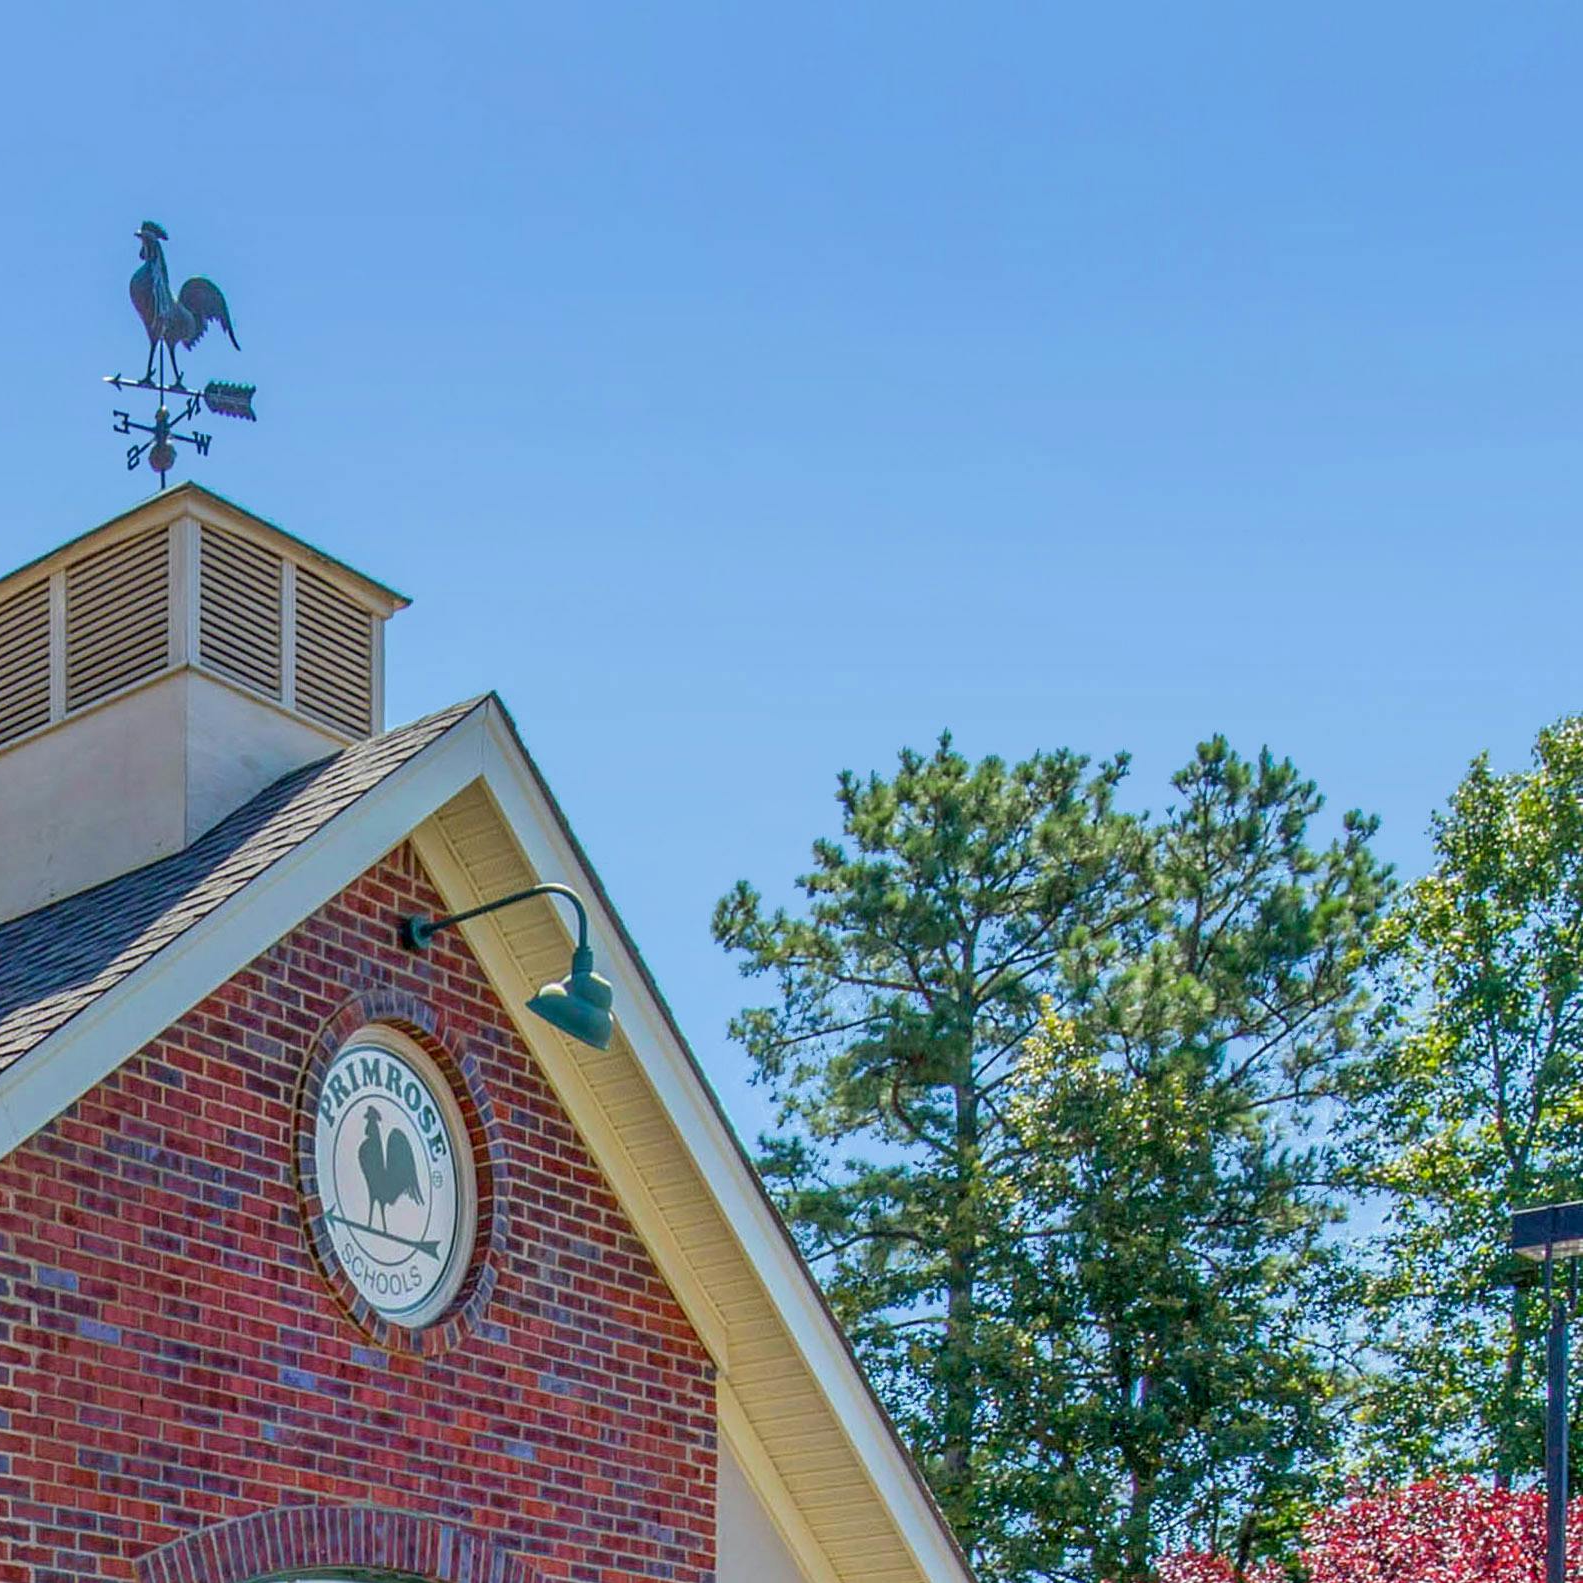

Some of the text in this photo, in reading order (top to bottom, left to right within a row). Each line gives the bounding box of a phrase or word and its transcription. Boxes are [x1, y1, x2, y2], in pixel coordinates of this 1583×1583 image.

[193, 431, 213, 456] W
[319, 1057, 447, 1163] PRIMROSE
[340, 1241, 423, 1296] SCHOOLS
